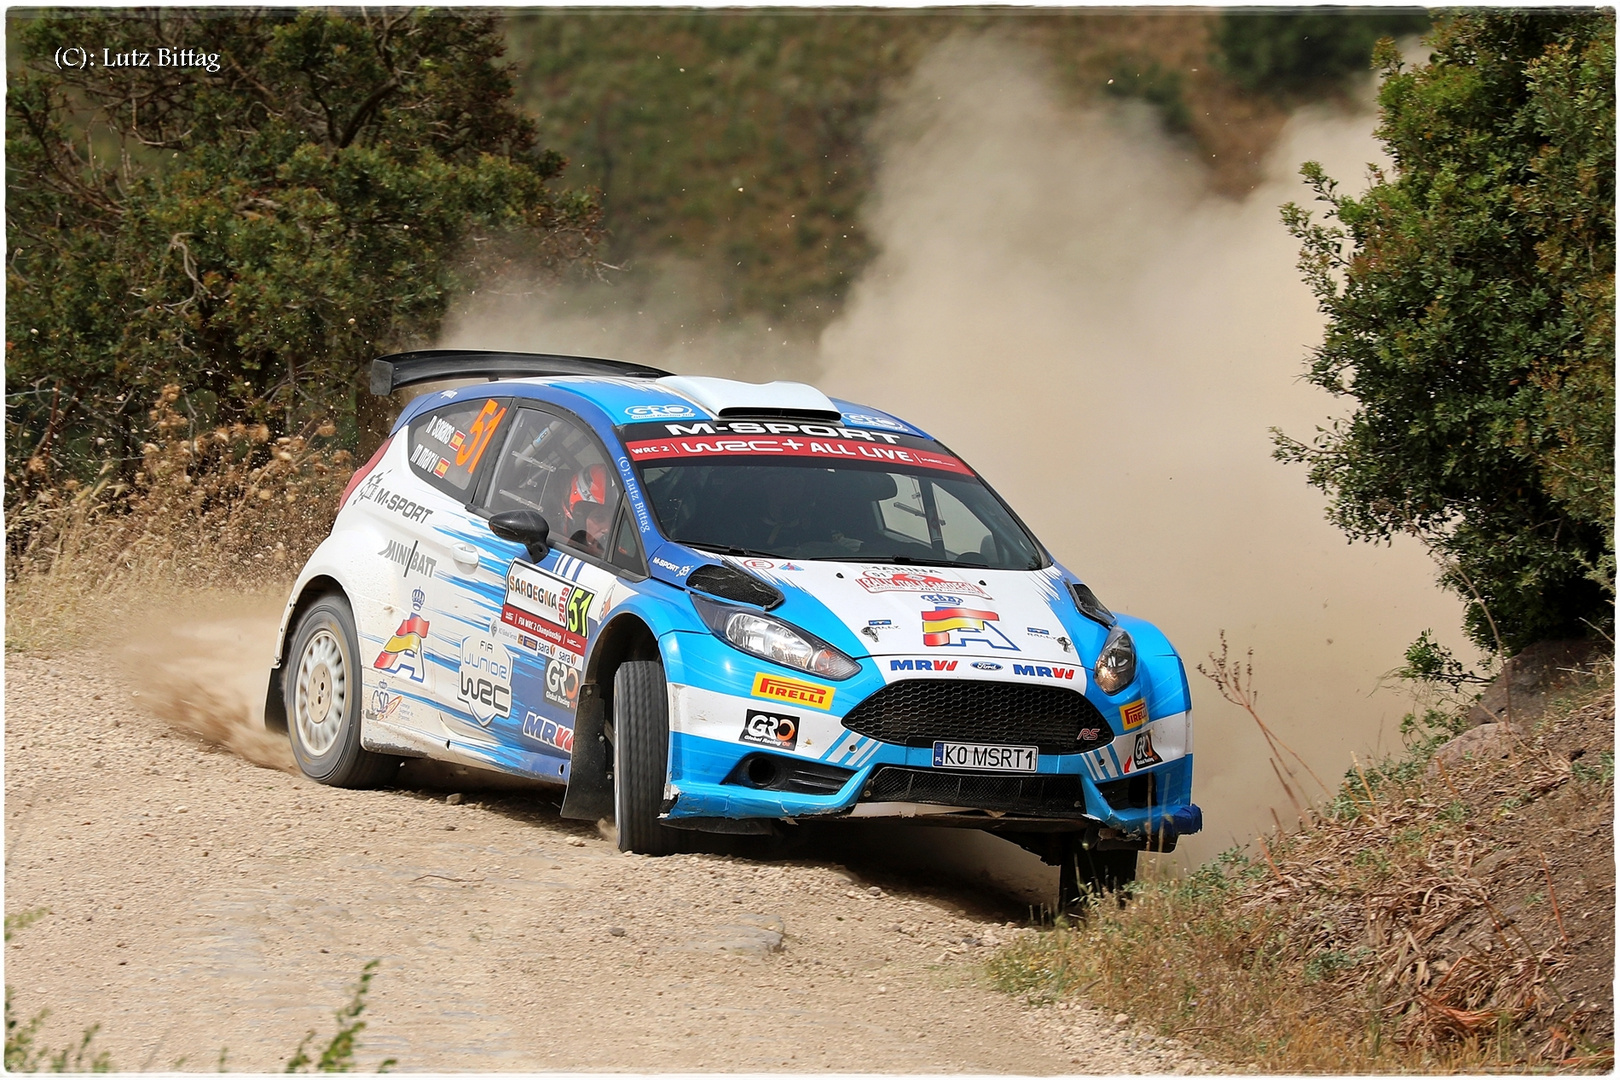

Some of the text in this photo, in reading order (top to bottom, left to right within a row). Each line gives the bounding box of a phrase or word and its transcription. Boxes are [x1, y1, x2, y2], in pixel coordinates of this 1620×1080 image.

[455, 399, 507, 474] 51
[664, 421, 901, 444] M-SPORT
[631, 446, 660, 455] WRC
[810, 441, 857, 456] ALL
[857, 445, 914, 462] LIVE
[373, 487, 434, 524] M-SPORT
[652, 556, 680, 573] M-SPORT
[509, 575, 558, 610] SARDEGNA
[558, 587, 570, 623] 2019
[568, 588, 593, 637] 51
[537, 624, 562, 643] Championship
[480, 640, 493, 653] FIA
[538, 641, 550, 656] sara
[558, 650, 571, 664] sara
[464, 653, 507, 680] JUNIOR
[975, 662, 998, 670] Ford
[546, 659, 578, 700] GRO
[760, 677, 827, 704] PIRELLI
[460, 671, 510, 713] WRC
[747, 714, 796, 741] GRO
[1077, 728, 1100, 740] RS
[762, 738, 782, 746] Racing
[973, 746, 1033, 770] MSRT1
